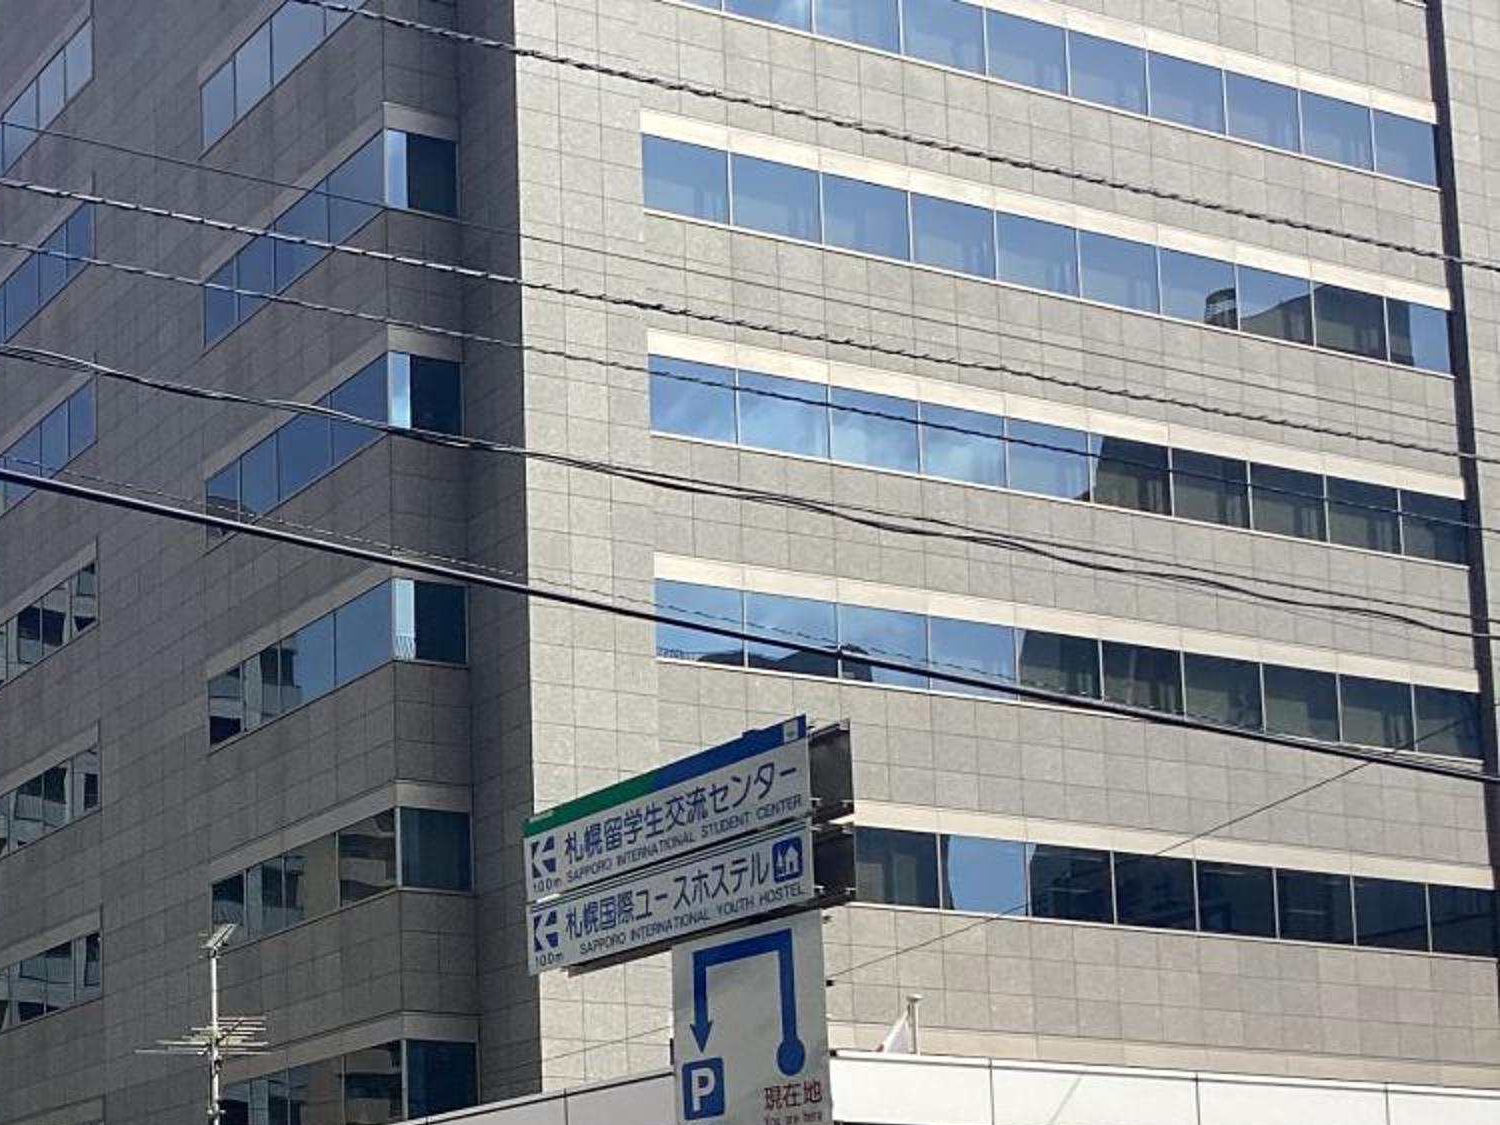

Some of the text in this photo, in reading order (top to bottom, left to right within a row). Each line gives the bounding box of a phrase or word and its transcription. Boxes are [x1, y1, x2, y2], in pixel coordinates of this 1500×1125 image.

[564, 762, 797, 864] 札幌留学生交流センター
[566, 794, 803, 883] SAPPORO INTERNATIONAL STUDENT CENTER
[533, 878, 563, 893] 100m
[565, 851, 769, 940] 札幌国際ユースホステル
[579, 883, 805, 956] SAPPORO INTERNATIONAL YOUTH HOSTEL
[534, 952, 565, 967] 100m
[691, 1067, 716, 1112] P
[764, 1078, 822, 1110] 現在地
